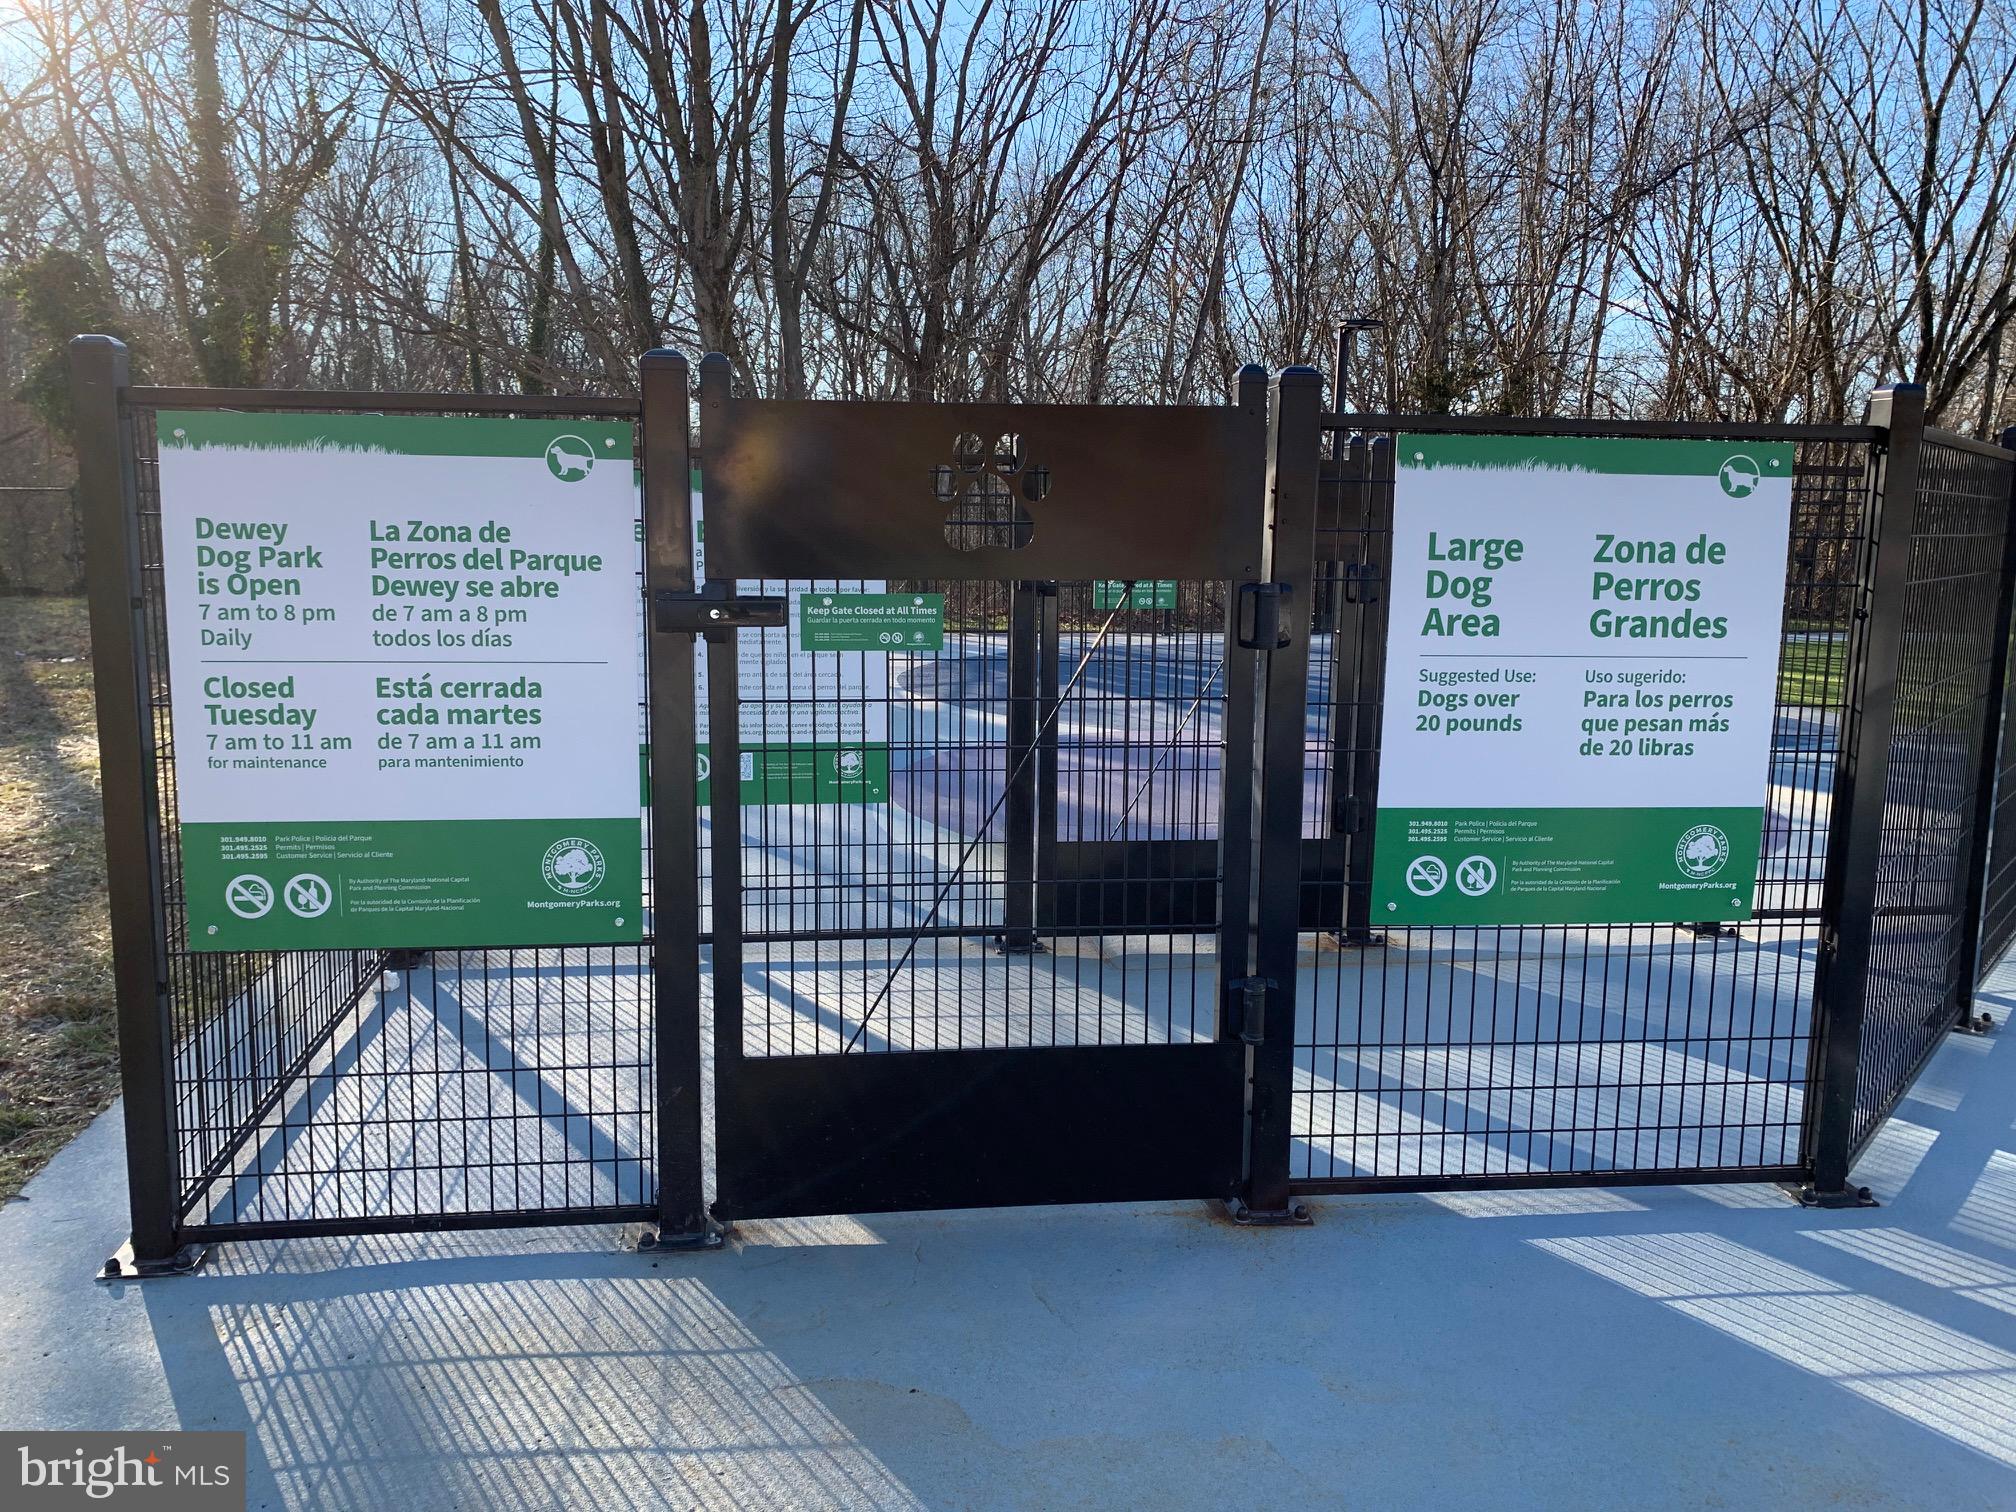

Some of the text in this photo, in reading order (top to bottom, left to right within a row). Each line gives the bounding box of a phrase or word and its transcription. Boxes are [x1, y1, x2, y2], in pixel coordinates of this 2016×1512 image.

[196, 518, 288, 548] Dewey
[370, 520, 510, 543] La Zona de
[1428, 532, 1523, 570] Large
[1594, 534, 1726, 564] Zona de
[197, 546, 323, 575] Dog Park
[371, 548, 602, 576] Perros del Parque
[198, 570, 300, 600] is Open
[372, 575, 559, 602] Dewey se abre
[1426, 570, 1492, 609] Dog
[1593, 572, 1701, 601] Perros
[199, 604, 335, 625] 7 am to 8 pm
[372, 604, 526, 625] de 7 am a 8 pm
[806, 616, 832, 624] Guardar
[832, 616, 839, 624] la
[838, 617, 860, 625] puerta
[891, 616, 907, 624] todo
[807, 606, 830, 617] Keep
[831, 606, 853, 615] Gate
[854, 606, 885, 615] Closed
[886, 606, 896, 615] at
[896, 606, 909, 615] All
[910, 606, 937, 615] Times
[1421, 609, 1500, 637] Area
[1590, 608, 1728, 638] Grandes
[201, 628, 252, 650] Daily
[372, 626, 512, 647] todos los días
[204, 676, 294, 698] Closed
[376, 673, 542, 698] Está cerrada
[1419, 668, 1536, 686] Suggested Use:
[1586, 669, 1685, 687] Uso sugerido:
[1418, 690, 1520, 712] Dogs over
[1584, 690, 1733, 711] Para los perros
[204, 703, 317, 731] Tuesday
[377, 703, 541, 725] cada martes
[1416, 714, 1522, 735] 20 pounds
[1582, 712, 1729, 737] que pesan más
[206, 734, 351, 750] 7 am to 11 am
[378, 732, 541, 749] de 7 am a 11 am
[1580, 738, 1694, 756] de 20 libras
[208, 756, 326, 768] for maintenance
[379, 755, 523, 771] para mantenimiento
[1678, 827, 1727, 863] MONTGOMERY PARKS
[545, 840, 603, 880] MONTGOMERY PARKS
[1659, 882, 1737, 891] MontgomeryParks.org
[527, 900, 621, 910] MontgomeryParks.org
